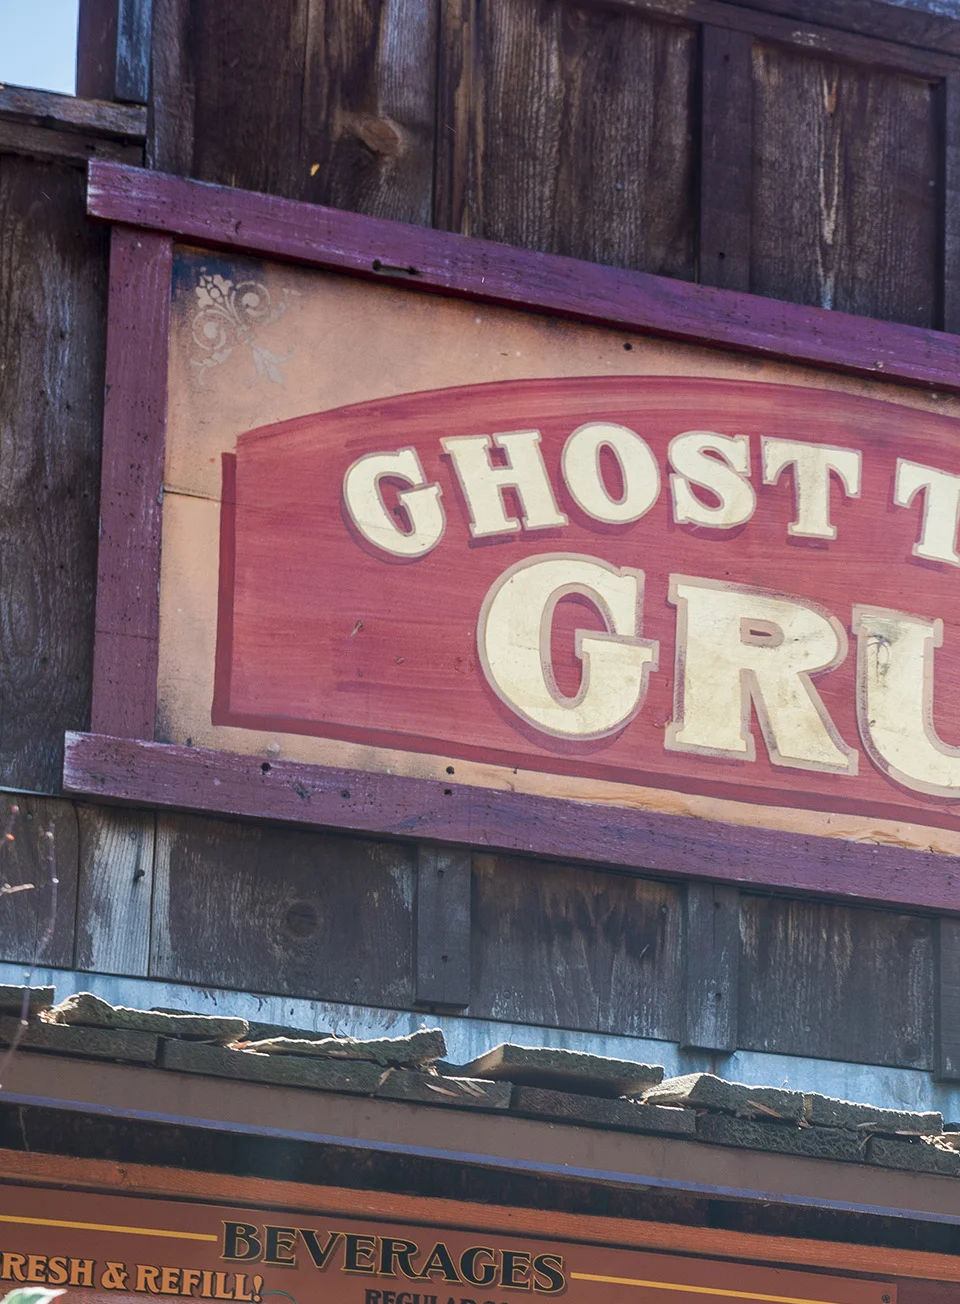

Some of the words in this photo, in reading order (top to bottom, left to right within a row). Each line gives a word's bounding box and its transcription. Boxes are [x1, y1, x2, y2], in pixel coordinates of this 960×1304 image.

[343, 422, 862, 558] GHOST
[101, 1261, 129, 1290] &
[135, 1264, 264, 1302] REFILL!
[220, 1220, 567, 1293] BEVERAGES
